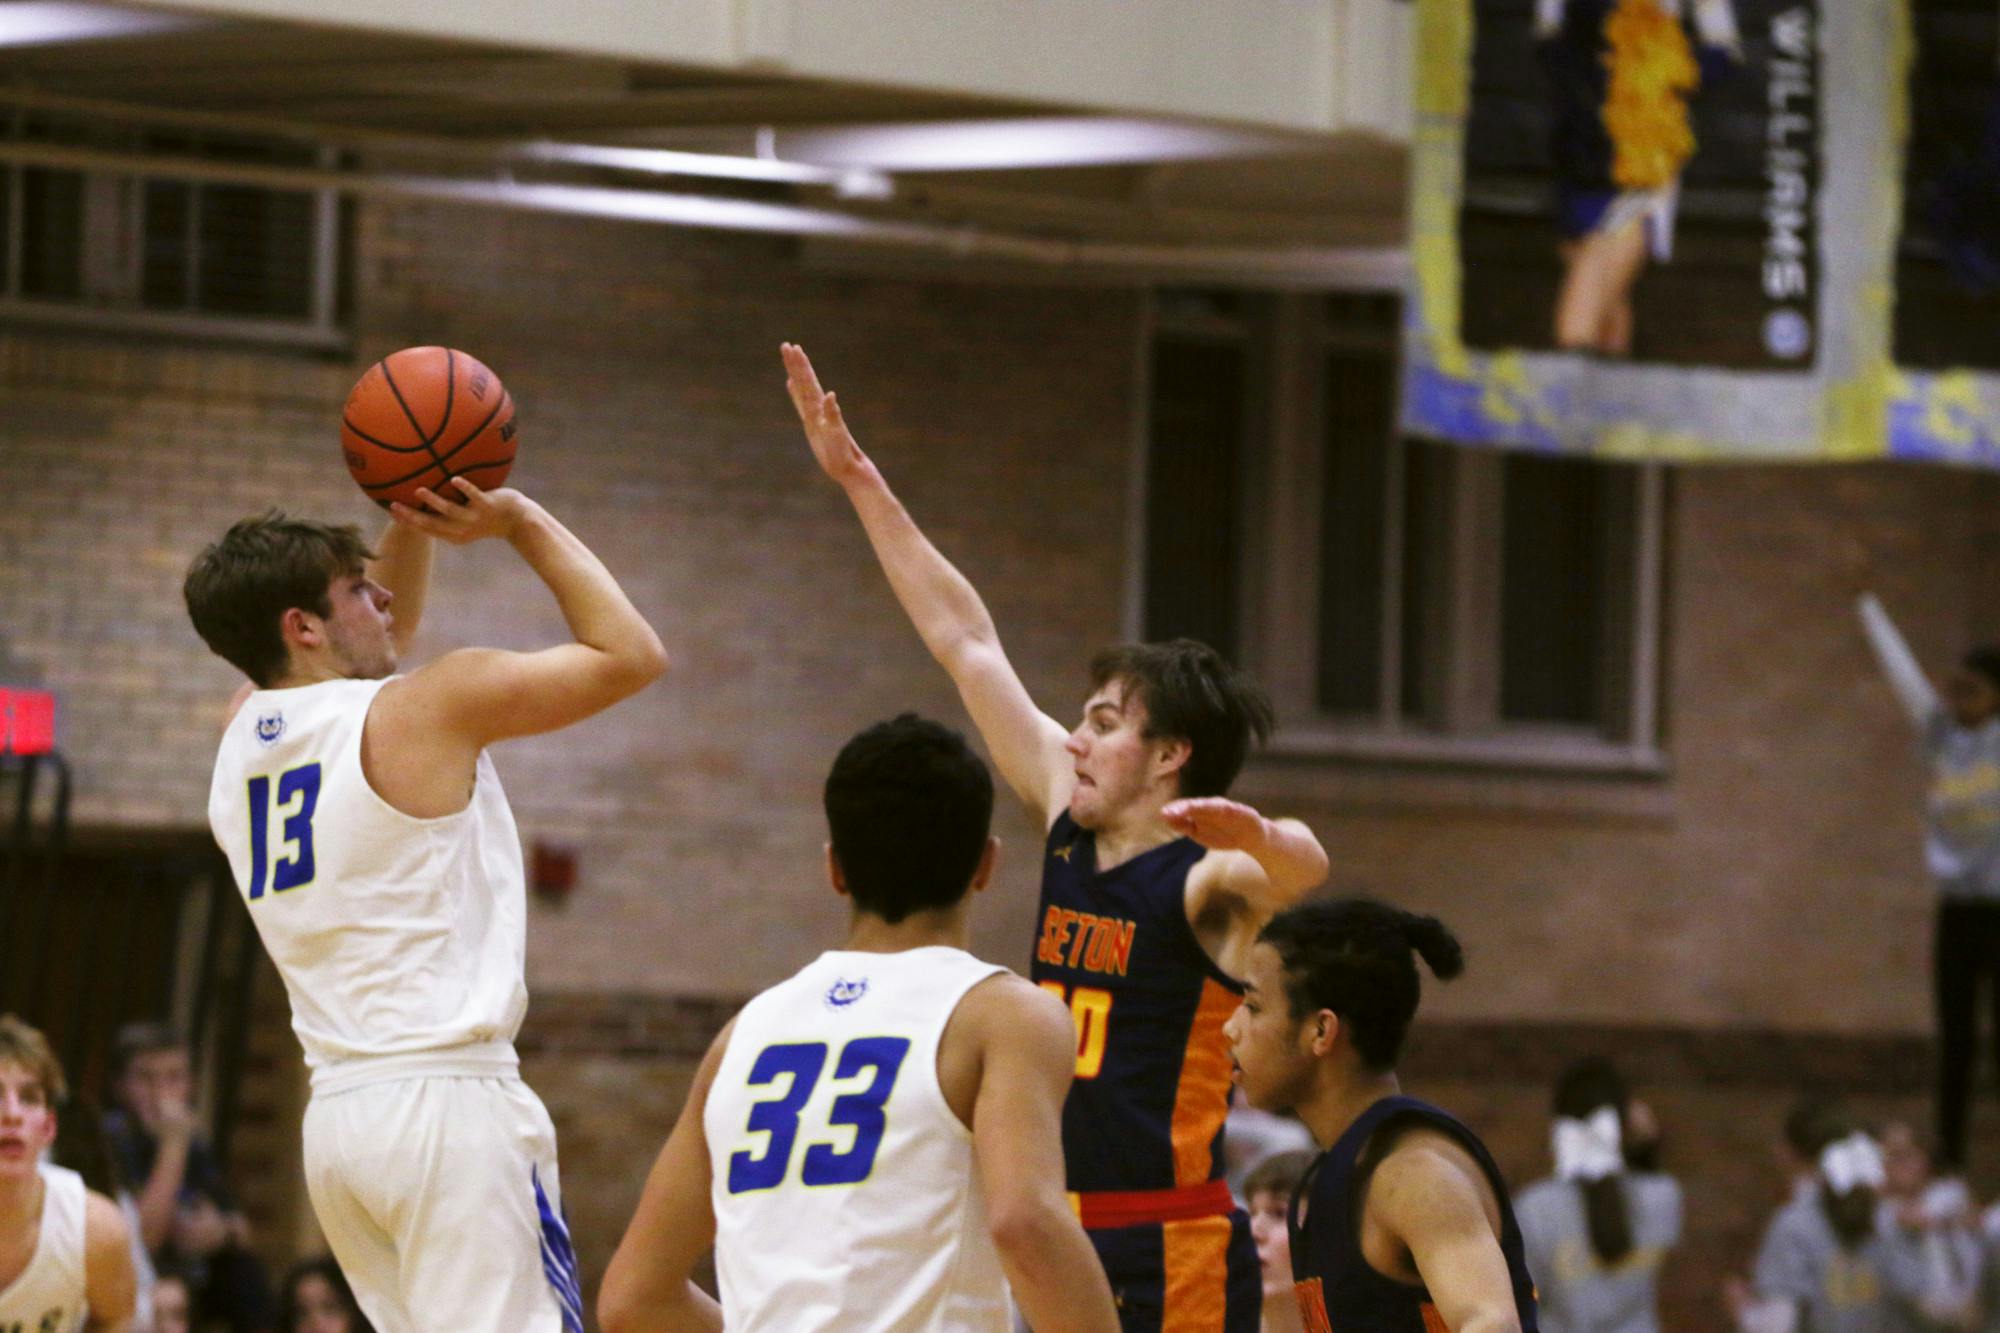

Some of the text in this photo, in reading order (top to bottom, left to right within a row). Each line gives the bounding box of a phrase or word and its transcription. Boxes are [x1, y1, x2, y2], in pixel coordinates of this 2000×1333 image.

[1763, 8, 1811, 299] WILLIAMS
[247, 761, 322, 902] 13
[1037, 904, 1137, 977] SETON
[1038, 980, 1114, 1081] 0
[726, 1034, 912, 1196] 33
